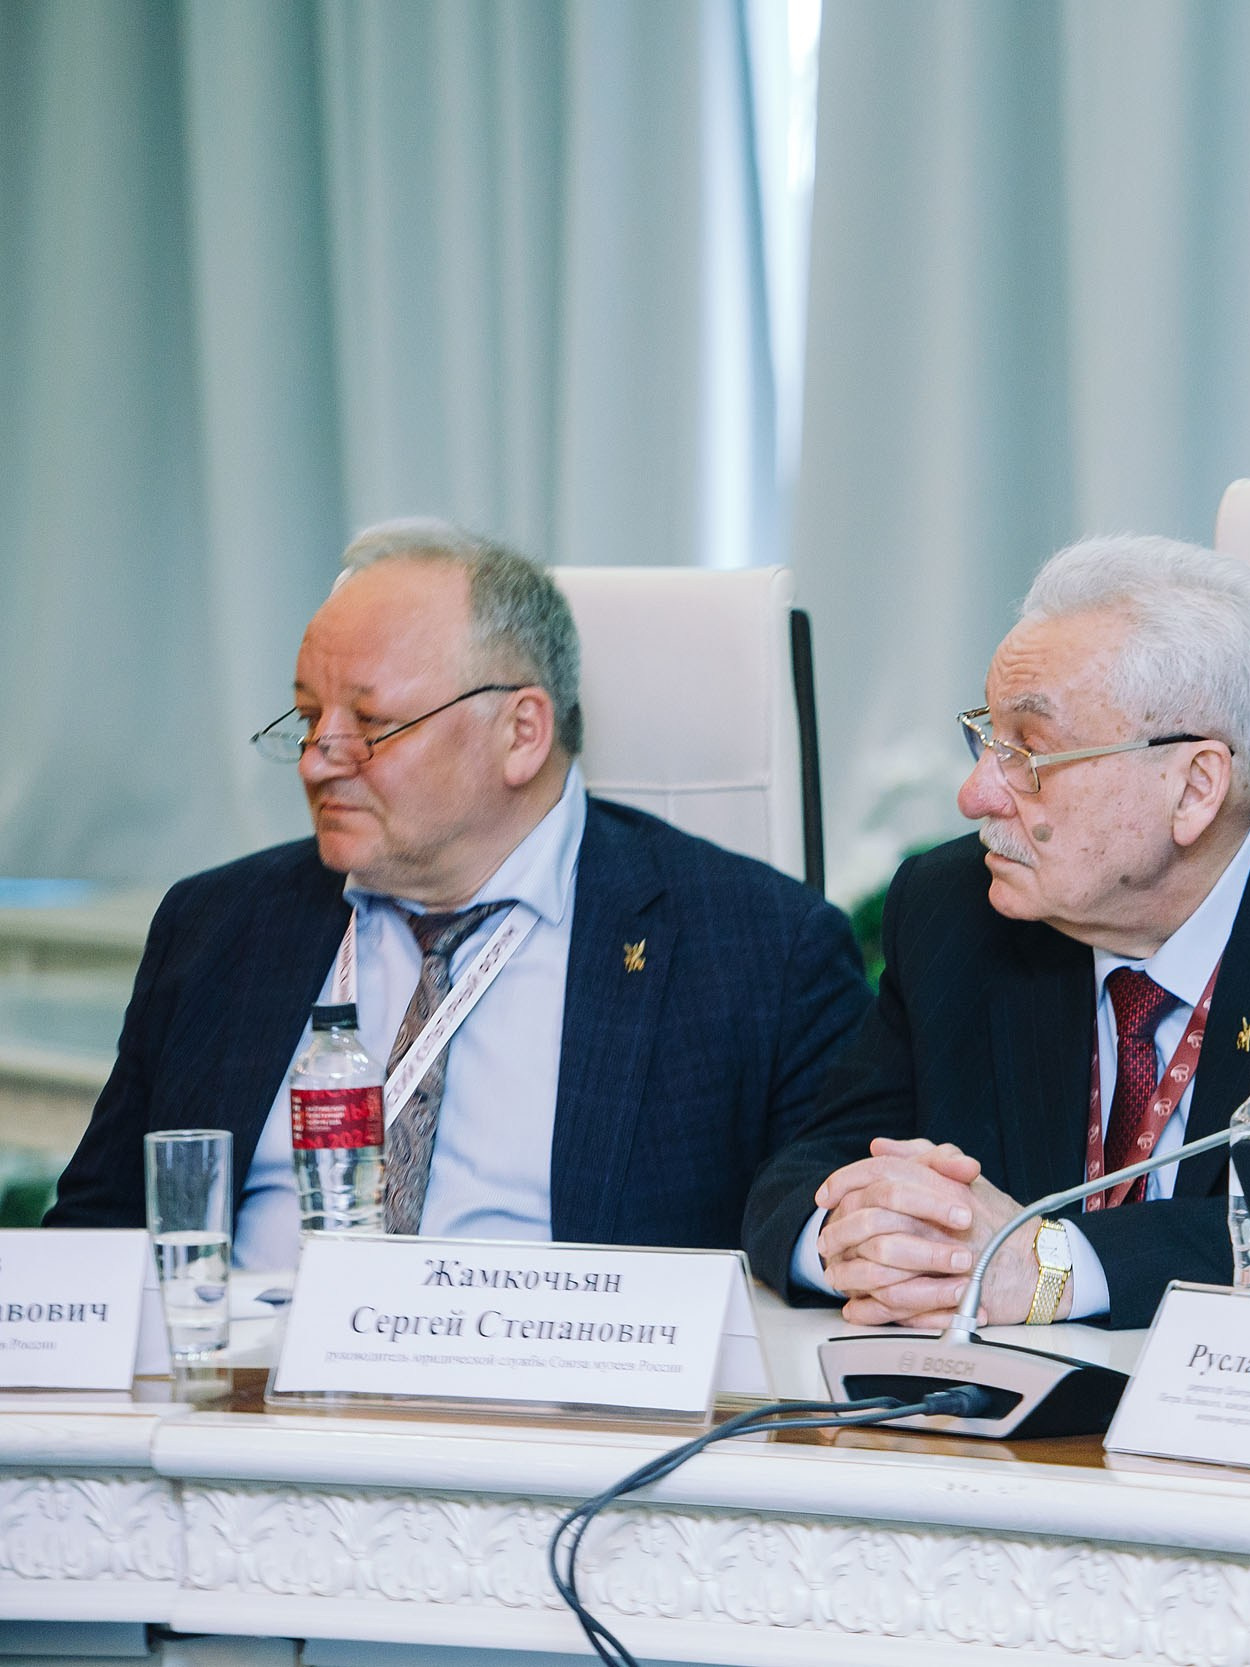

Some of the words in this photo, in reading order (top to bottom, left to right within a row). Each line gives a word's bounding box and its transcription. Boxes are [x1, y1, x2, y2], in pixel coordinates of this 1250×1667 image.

[421, 1258, 624, 1293] Жамкочьян
[0, 1302, 109, 1323] вович
[350, 1304, 464, 1342] Сергей
[477, 1309, 680, 1346] Степанович
[922, 1356, 977, 1377] BOSCH
